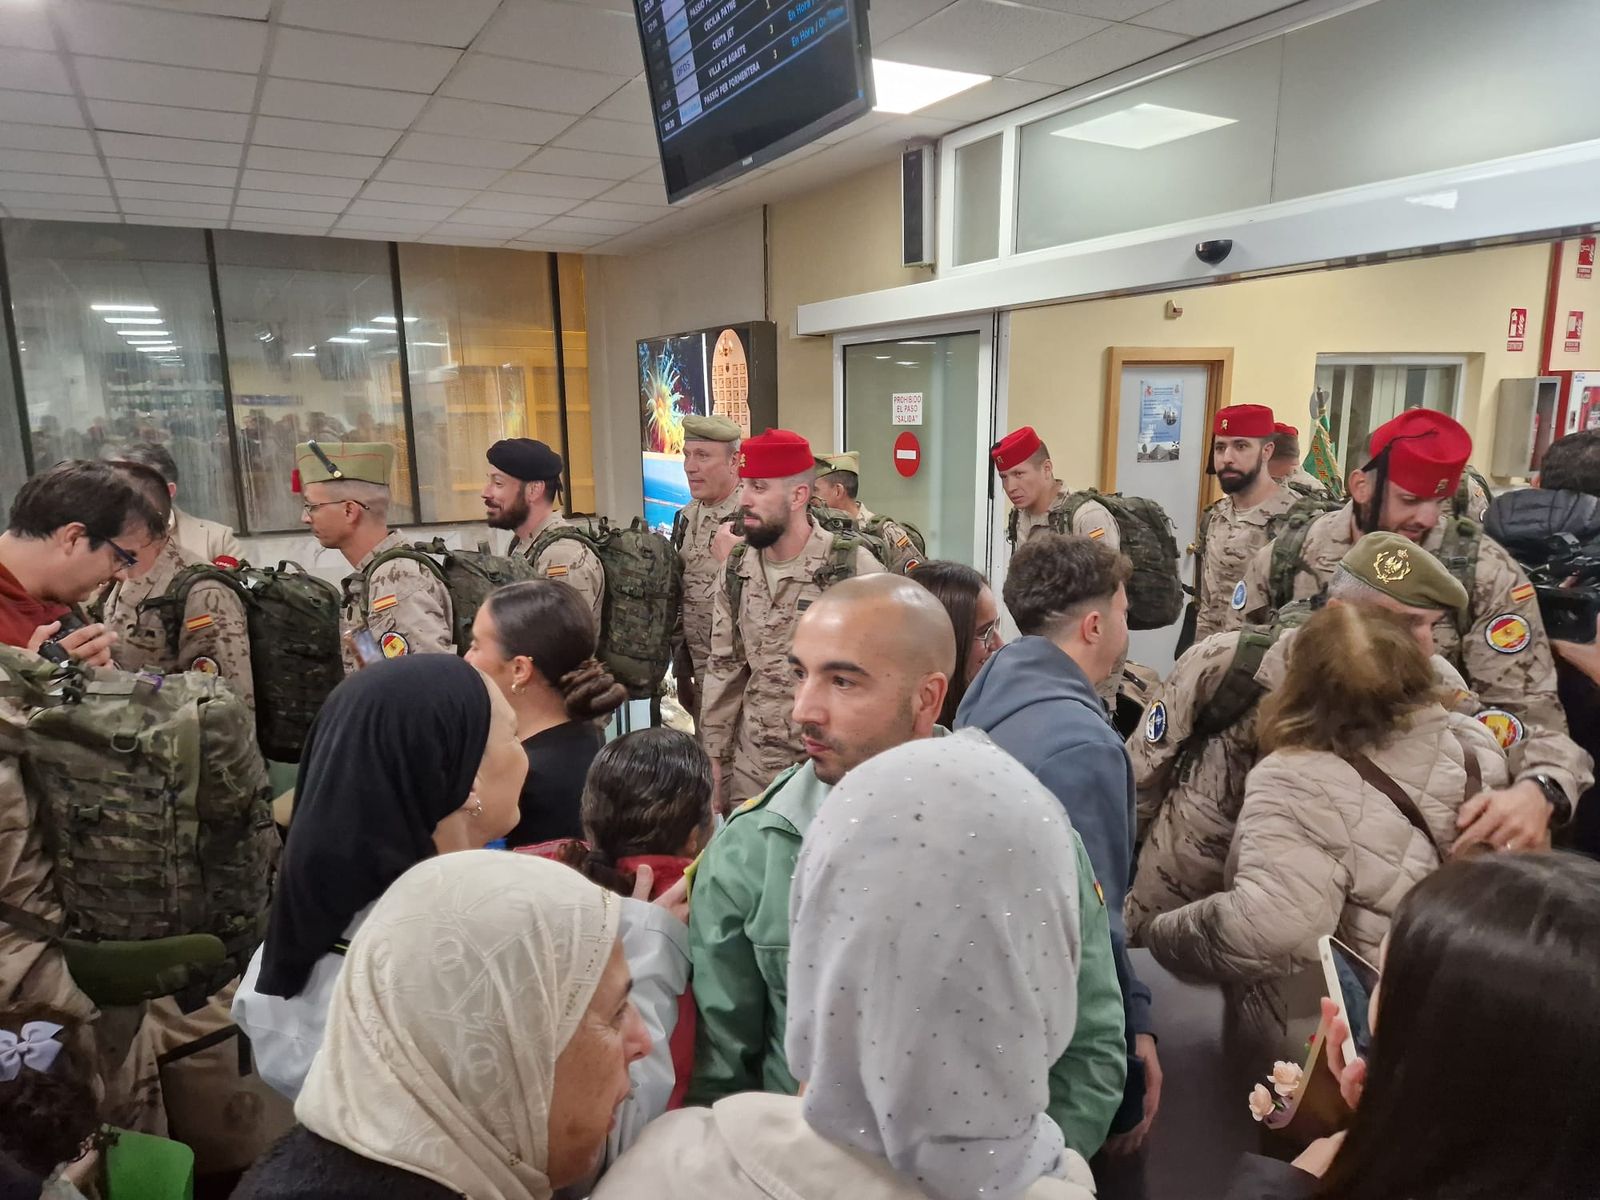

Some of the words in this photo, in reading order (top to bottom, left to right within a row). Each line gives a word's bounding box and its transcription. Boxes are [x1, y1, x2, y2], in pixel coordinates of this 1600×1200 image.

[708, 62, 721, 78] VILLA
[720, 57, 728, 69] DE
[719, 81, 729, 95] PER
[728, 61, 760, 88] FORMENTERA
[791, 36, 799, 47] En
[897, 405, 903, 413] EL
[904, 404, 918, 412] PASO
